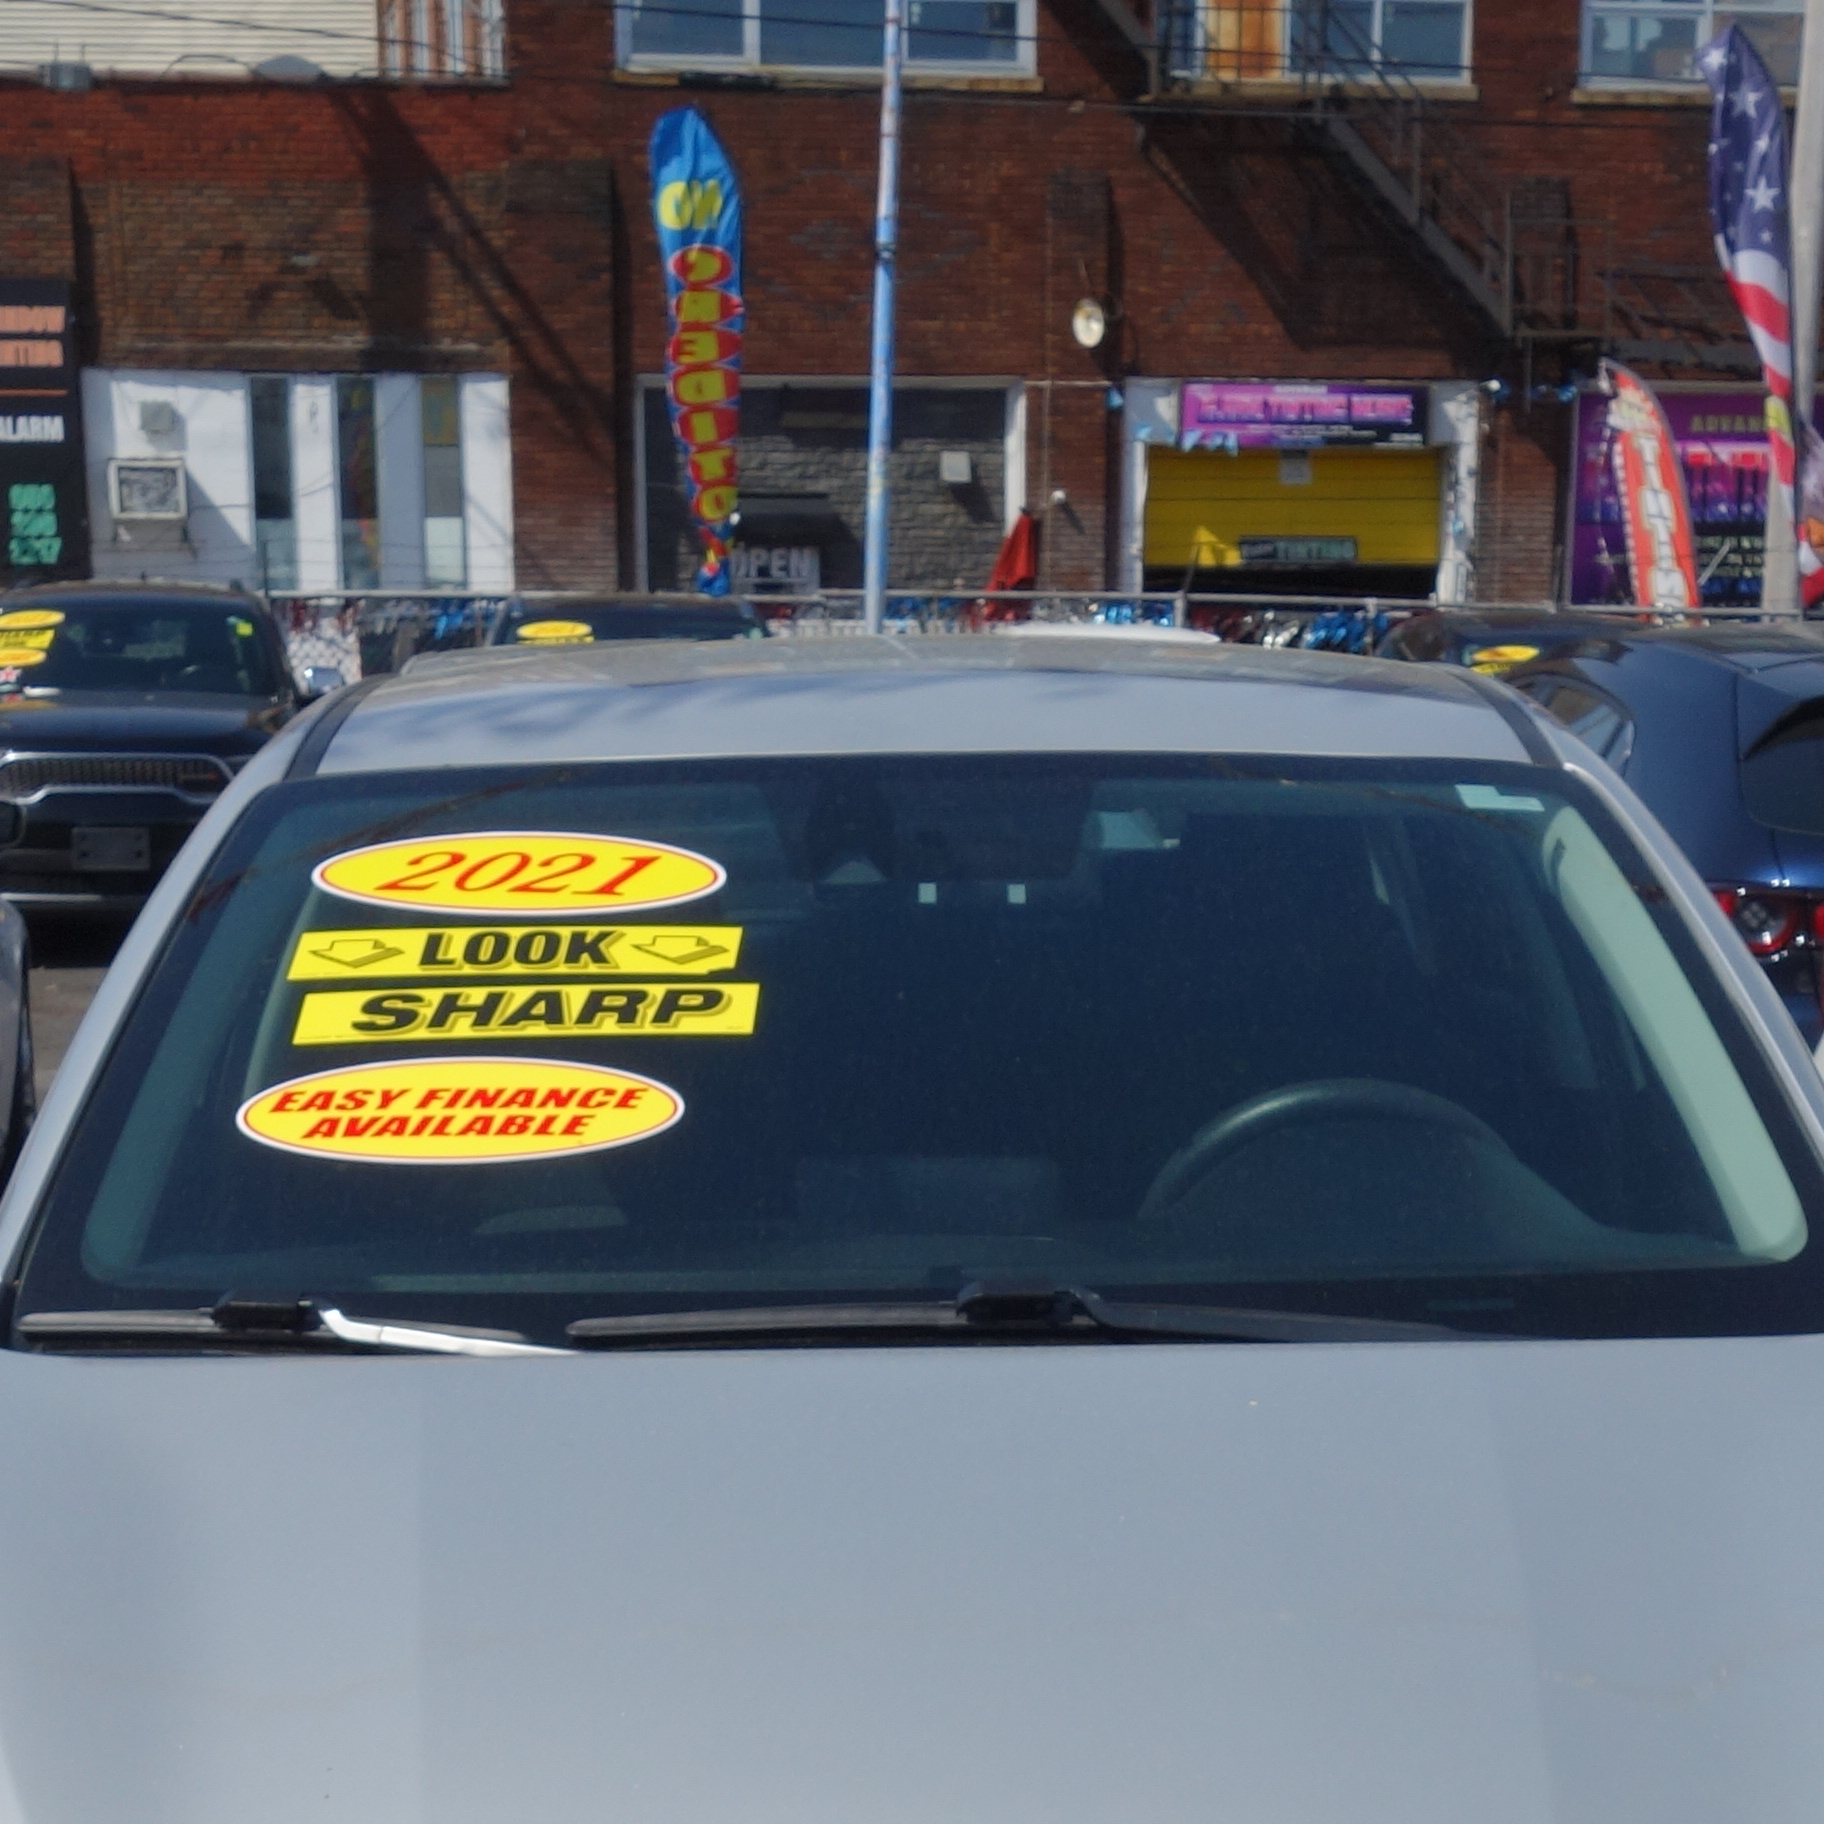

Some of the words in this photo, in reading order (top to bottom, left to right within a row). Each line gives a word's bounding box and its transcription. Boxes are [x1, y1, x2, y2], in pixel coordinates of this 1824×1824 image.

[375, 850, 663, 896] 2021
[418, 930, 624, 970] LOOK
[351, 988, 734, 1034] SHARP
[269, 1088, 410, 1113] EASY
[414, 1087, 650, 1110] FINANCE
[301, 1114, 597, 1139] AVAILABLE
